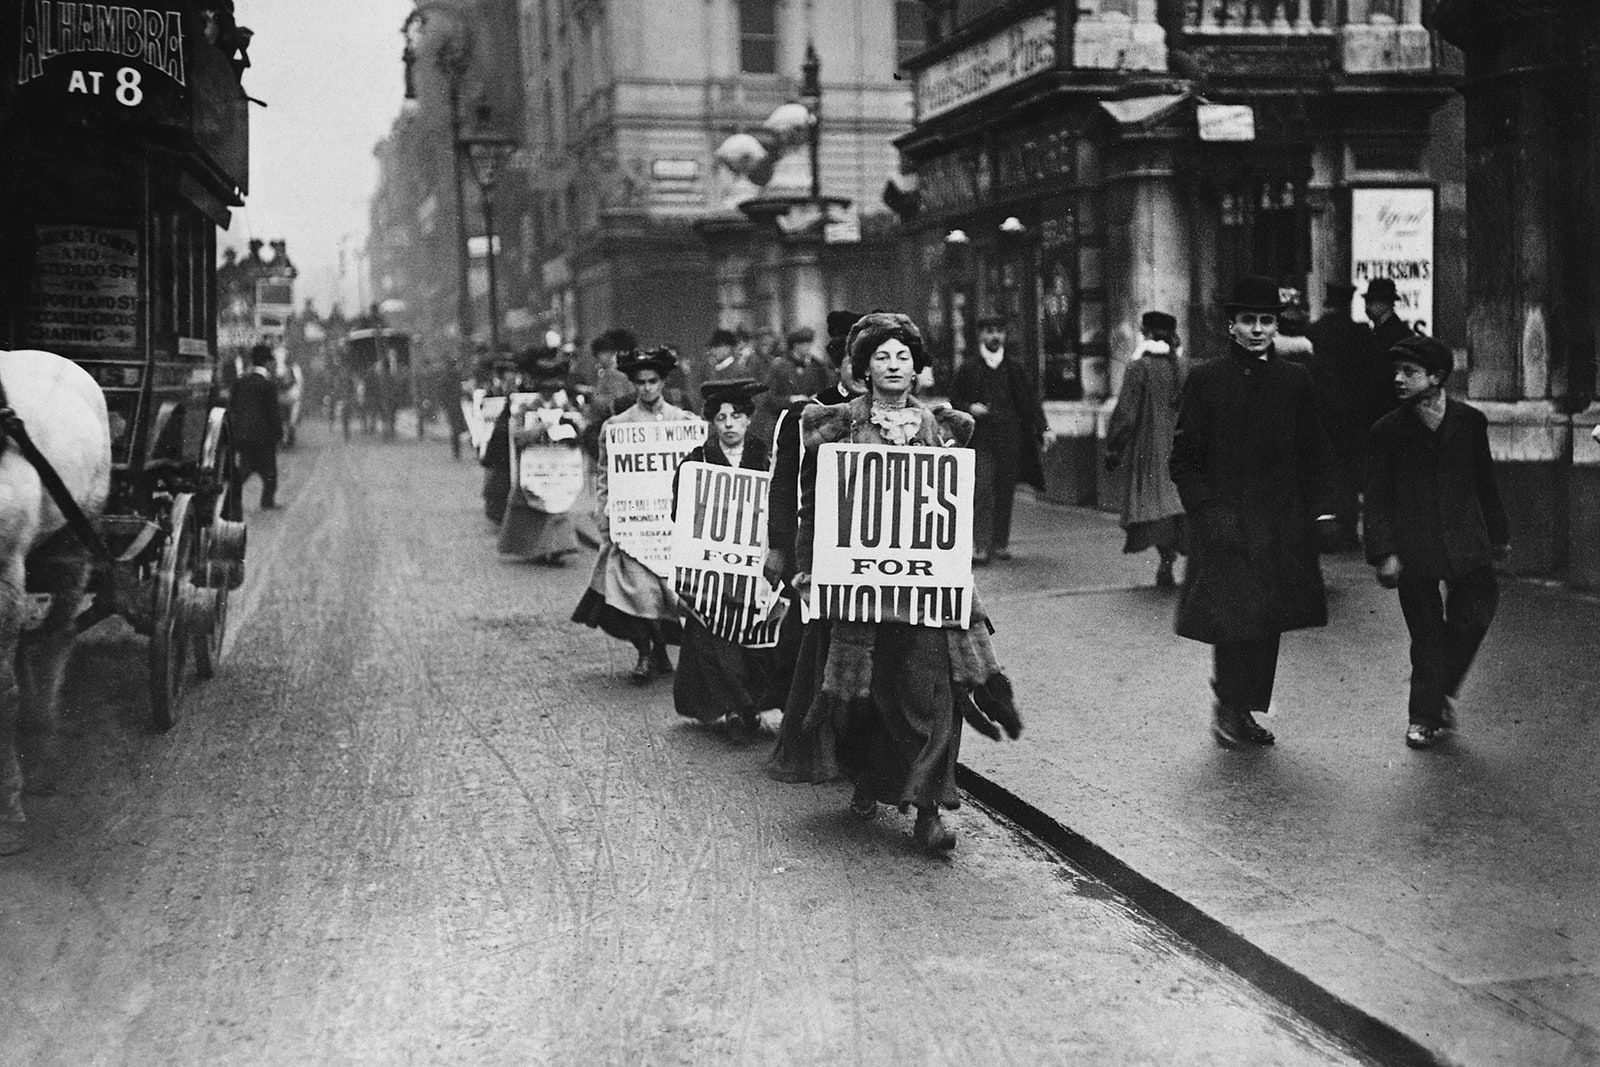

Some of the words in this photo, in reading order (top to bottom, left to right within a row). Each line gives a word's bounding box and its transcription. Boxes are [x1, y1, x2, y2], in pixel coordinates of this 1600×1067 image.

[18, 0, 186, 87] ALHAMBRA
[68, 70, 104, 94] AT
[115, 67, 143, 106] 8
[610, 427, 646, 444] VOTES
[665, 425, 705, 443] WOMEN
[693, 469, 769, 547] VOTE
[836, 451, 957, 550] VOTES
[851, 559, 934, 576] FOR
